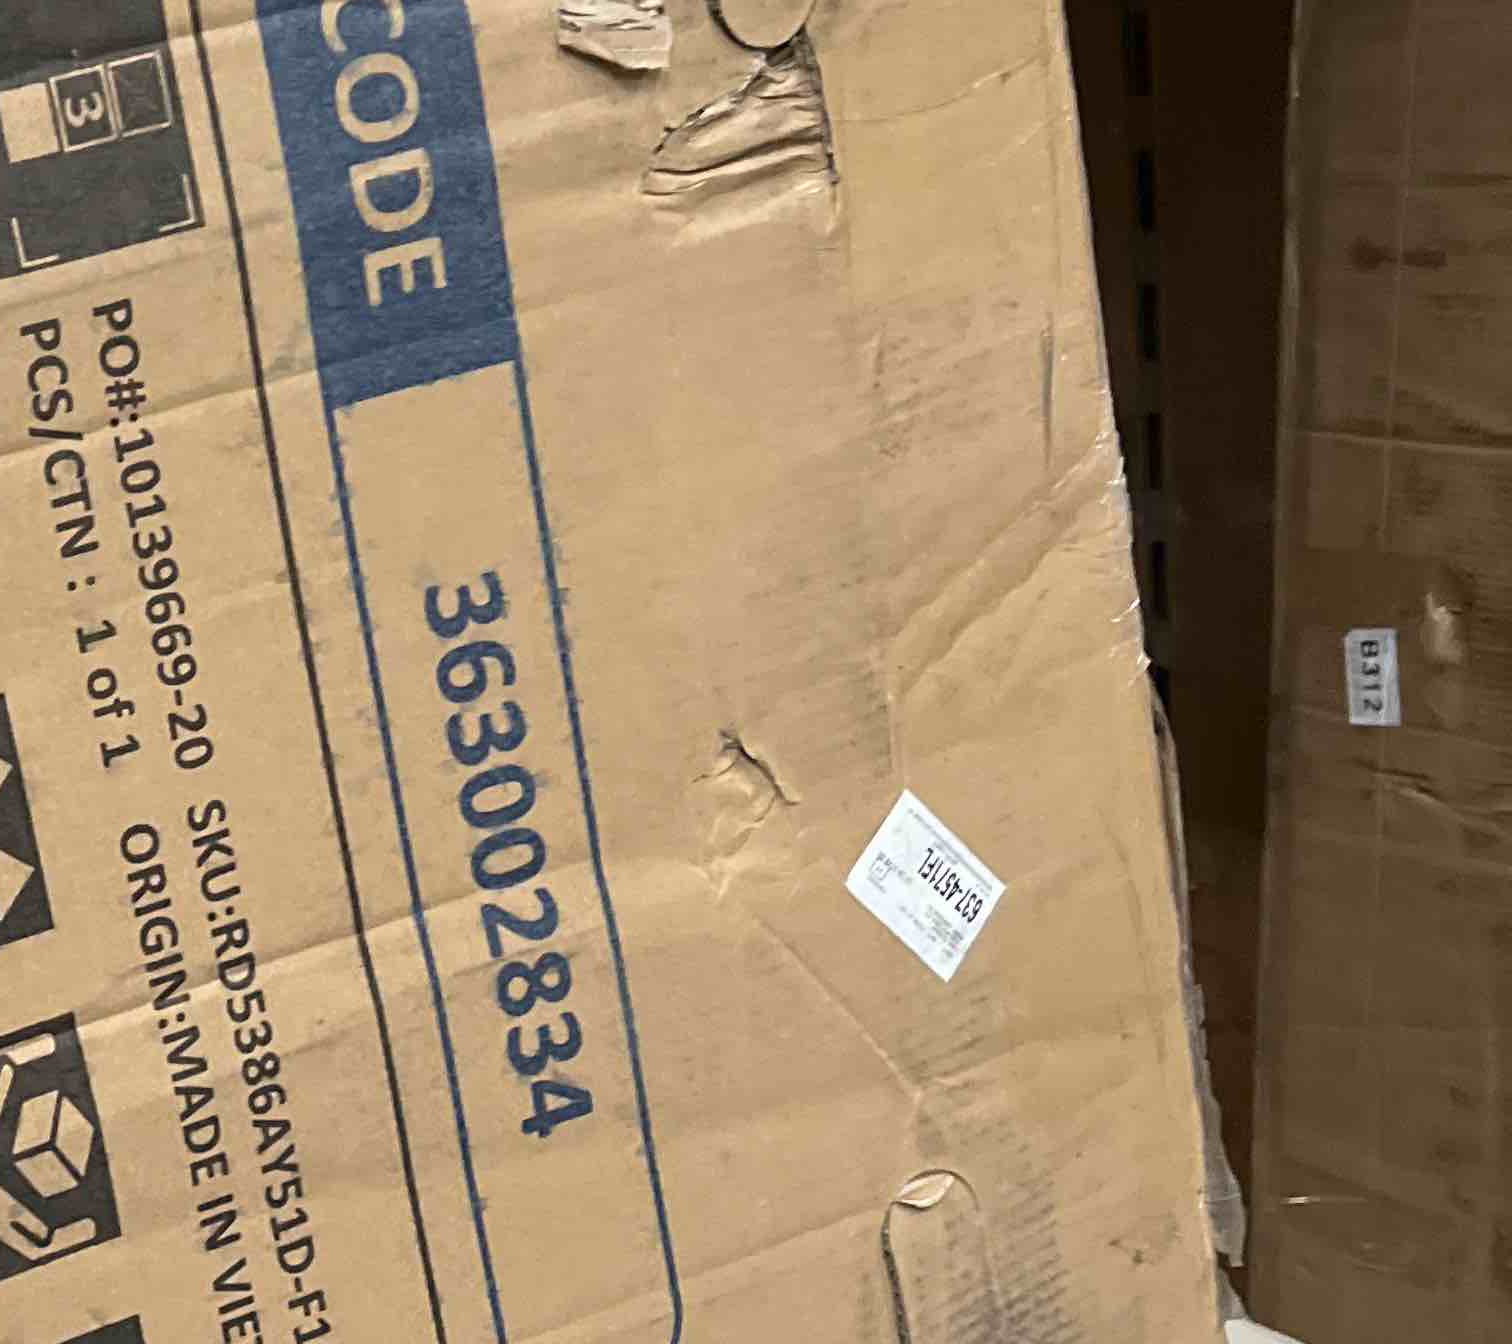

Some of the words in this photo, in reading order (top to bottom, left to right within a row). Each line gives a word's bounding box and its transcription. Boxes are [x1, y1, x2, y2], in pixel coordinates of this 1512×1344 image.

[92, 298, 213, 770] PO#:10139669-20
[76, 620, 117, 654] 1
[87, 667, 136, 720] of
[99, 736, 141, 769] 1
[424, 570, 594, 1138] 363002834
[196, 1194, 242, 1252] IN
